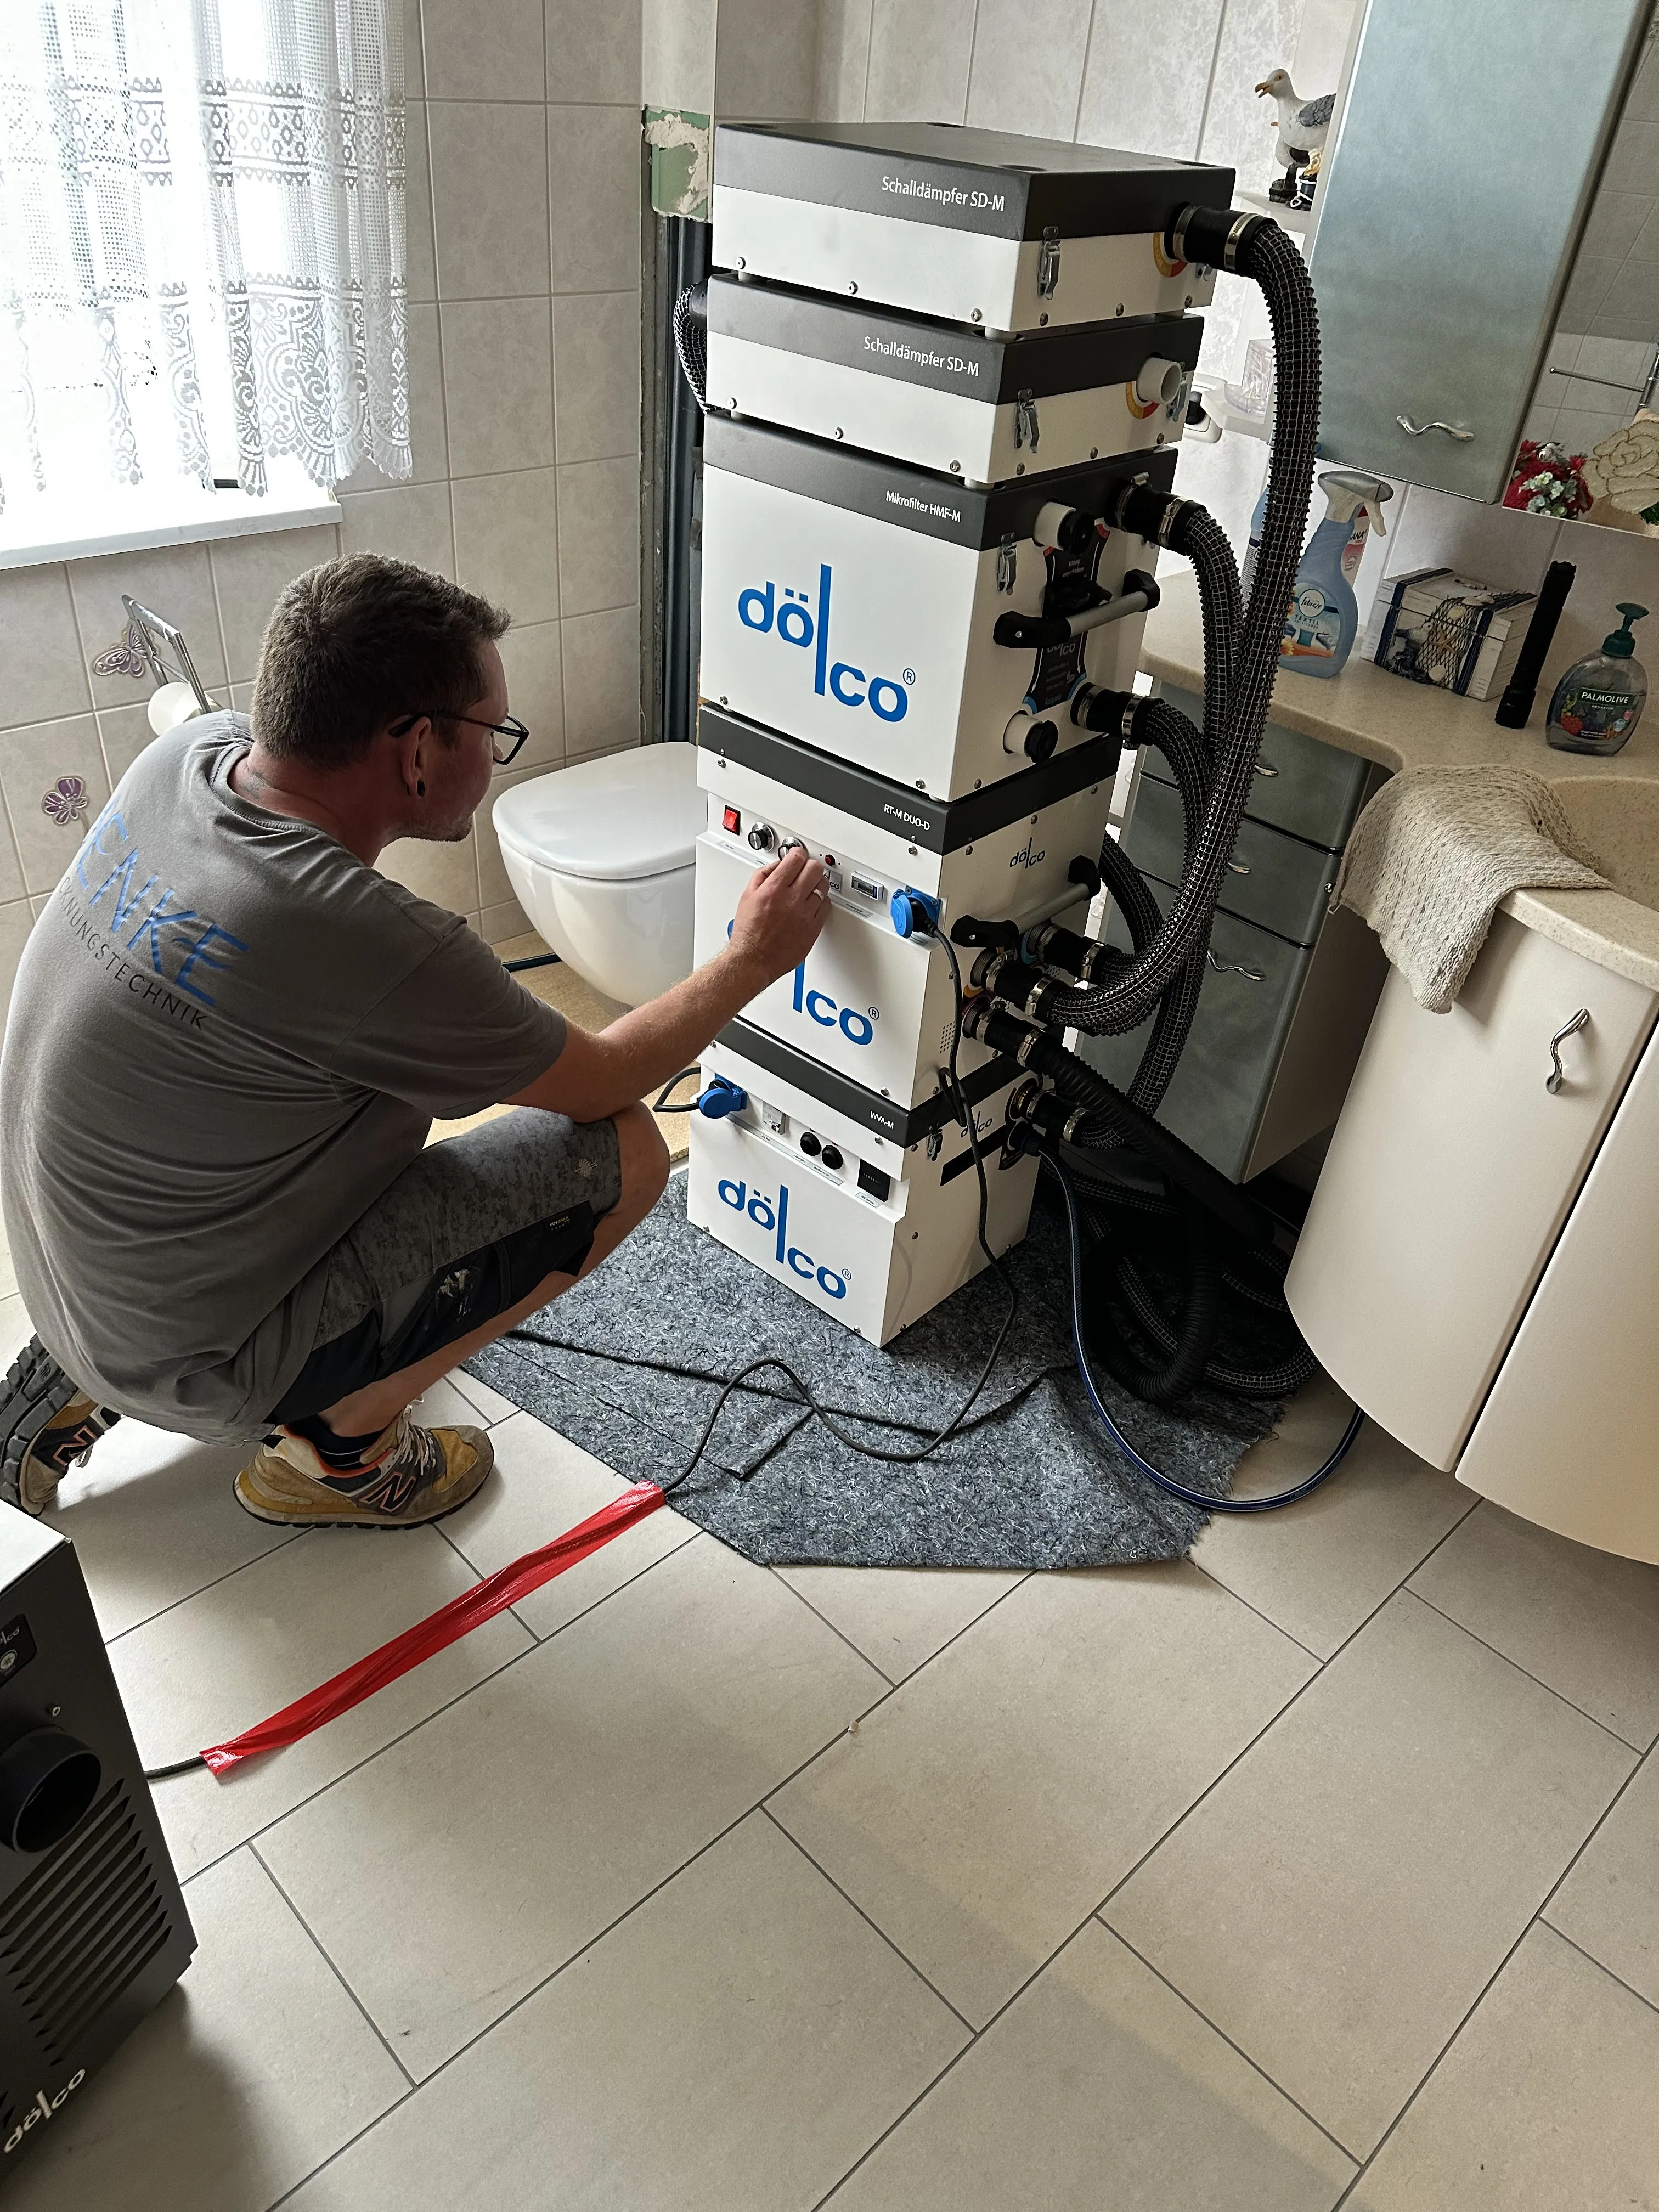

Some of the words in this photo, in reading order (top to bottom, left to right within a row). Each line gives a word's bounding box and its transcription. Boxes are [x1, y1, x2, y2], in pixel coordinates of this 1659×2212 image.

[882, 176, 968, 206] Schalldämpfer
[970, 191, 1005, 212] SD-M
[864, 336, 945, 367] Schalldämpfer
[946, 356, 979, 376] SD-M
[885, 490, 928, 512] Mikrofilter
[929, 503, 961, 522] HMF-M
[1350, 531, 1364, 541] ANA
[1301, 596, 1323, 610] febreze
[1295, 614, 1319, 625] TEXTIL
[1581, 691, 1629, 704] PALMOLIVE
[884, 803, 903, 820] RT-M
[903, 812, 931, 831] DUO-D
[1009, 837, 1046, 869] dölco
[75, 795, 250, 1006] ENKE
[870, 1110, 894, 1130] WVA-M
[4, 2068, 86, 2153] dölco
